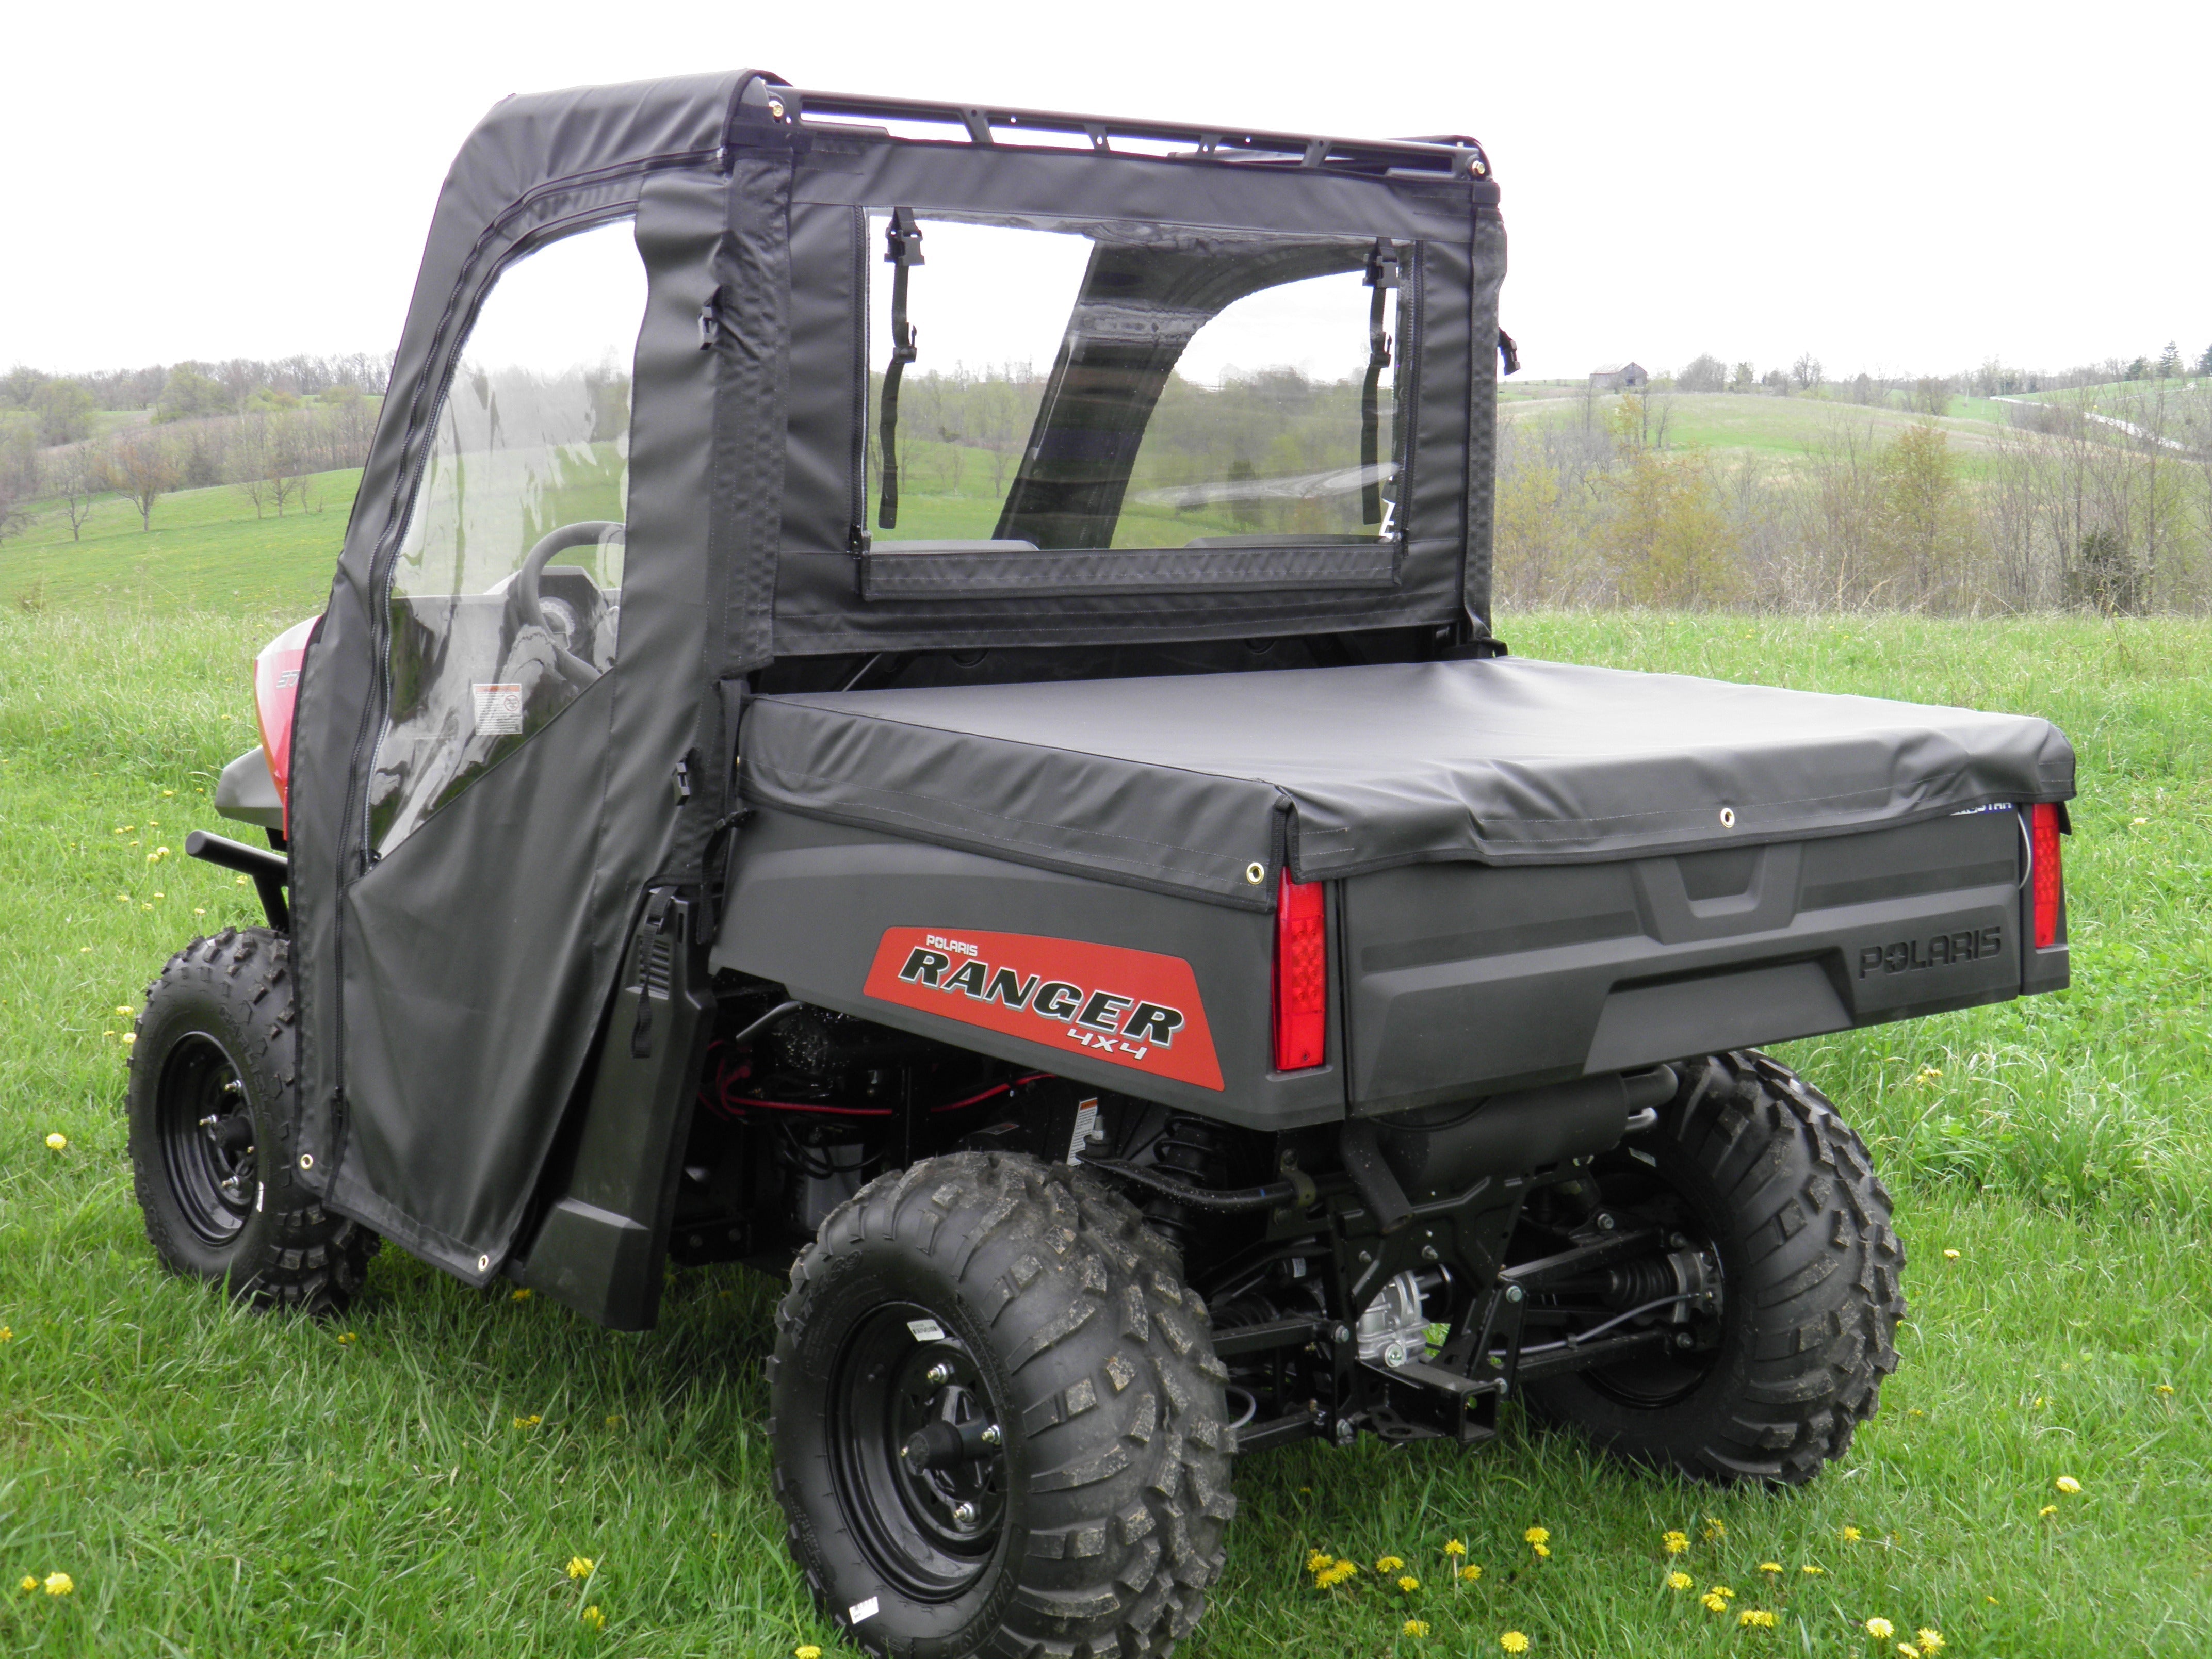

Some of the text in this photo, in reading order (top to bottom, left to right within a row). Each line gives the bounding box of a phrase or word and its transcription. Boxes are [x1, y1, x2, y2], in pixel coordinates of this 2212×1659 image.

[926, 935, 978, 957] POLARIS
[1859, 926, 2002, 980] POLARIS
[898, 946, 1185, 1048] RANGER
